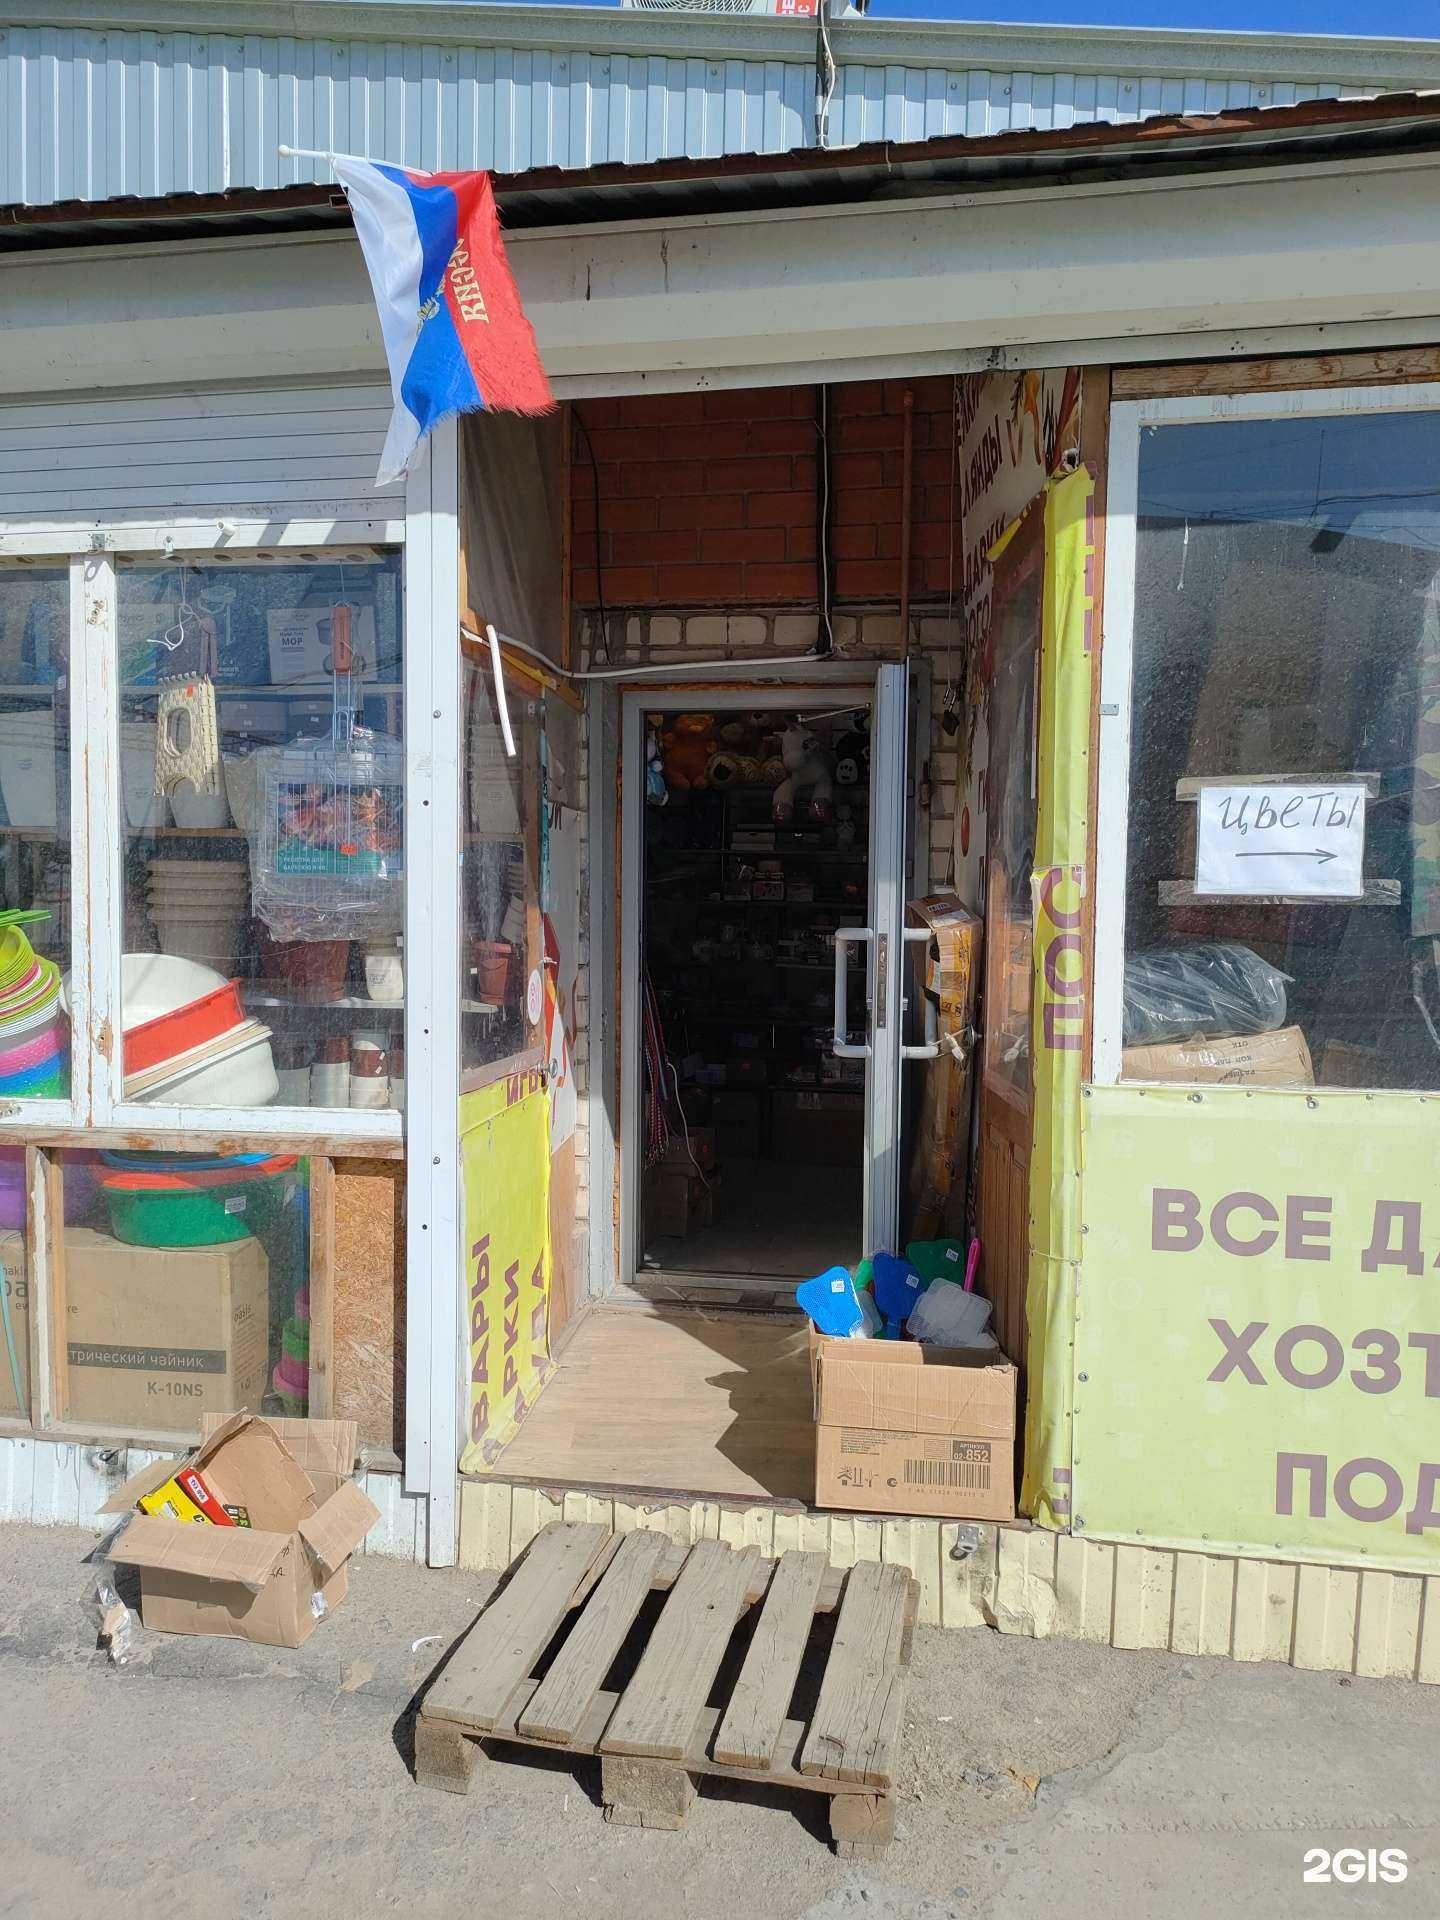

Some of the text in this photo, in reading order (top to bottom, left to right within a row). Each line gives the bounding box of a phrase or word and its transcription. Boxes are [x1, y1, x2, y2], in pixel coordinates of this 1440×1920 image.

[447, 238, 490, 323] ССИЯ
[1151, 1187, 1440, 1276] ВСЕ Д
[150, 1352, 204, 1368] чайник
[1206, 1318, 1440, 1399] ХОЗТ
[953, 1449, 989, 1462] 02-852
